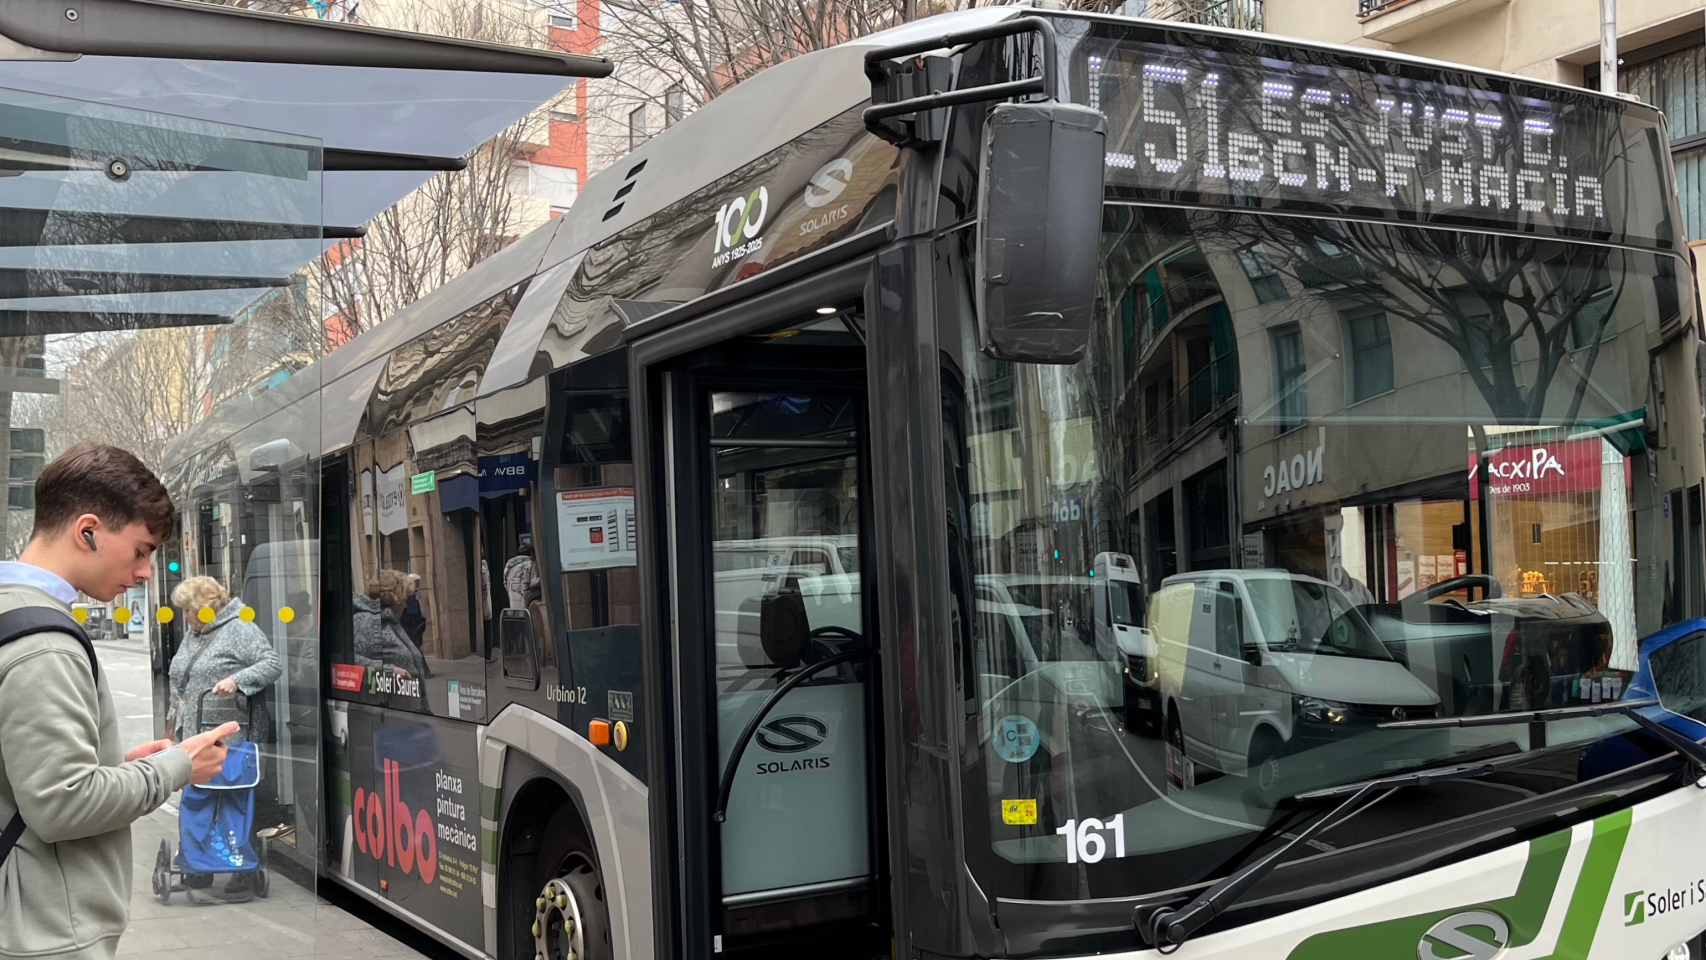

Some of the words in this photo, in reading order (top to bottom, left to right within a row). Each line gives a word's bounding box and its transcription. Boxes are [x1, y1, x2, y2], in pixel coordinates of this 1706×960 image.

[1365, 98, 1503, 159] JUST
[713, 186, 769, 254] 100
[799, 205, 848, 236] SOLARIS
[711, 251, 730, 269] ANYS
[731, 236, 763, 261] 1925-2025
[1468, 448, 1565, 480] ACXIPA
[1502, 484, 1511, 493] de
[1512, 483, 1531, 493] 1903
[376, 671, 392, 693] Soler
[397, 673, 420, 698] Sauret
[546, 684, 575, 704] Urbino
[576, 686, 587, 705] 12
[756, 757, 830, 774] SOLARIS
[436, 769, 463, 794] planxa
[354, 757, 437, 884] colbo
[436, 795, 466, 821] pintura
[437, 821, 477, 851] mecànica
[1056, 813, 1126, 864] 161
[1647, 888, 1687, 917] Soler
[1690, 881, 1694, 905] i
